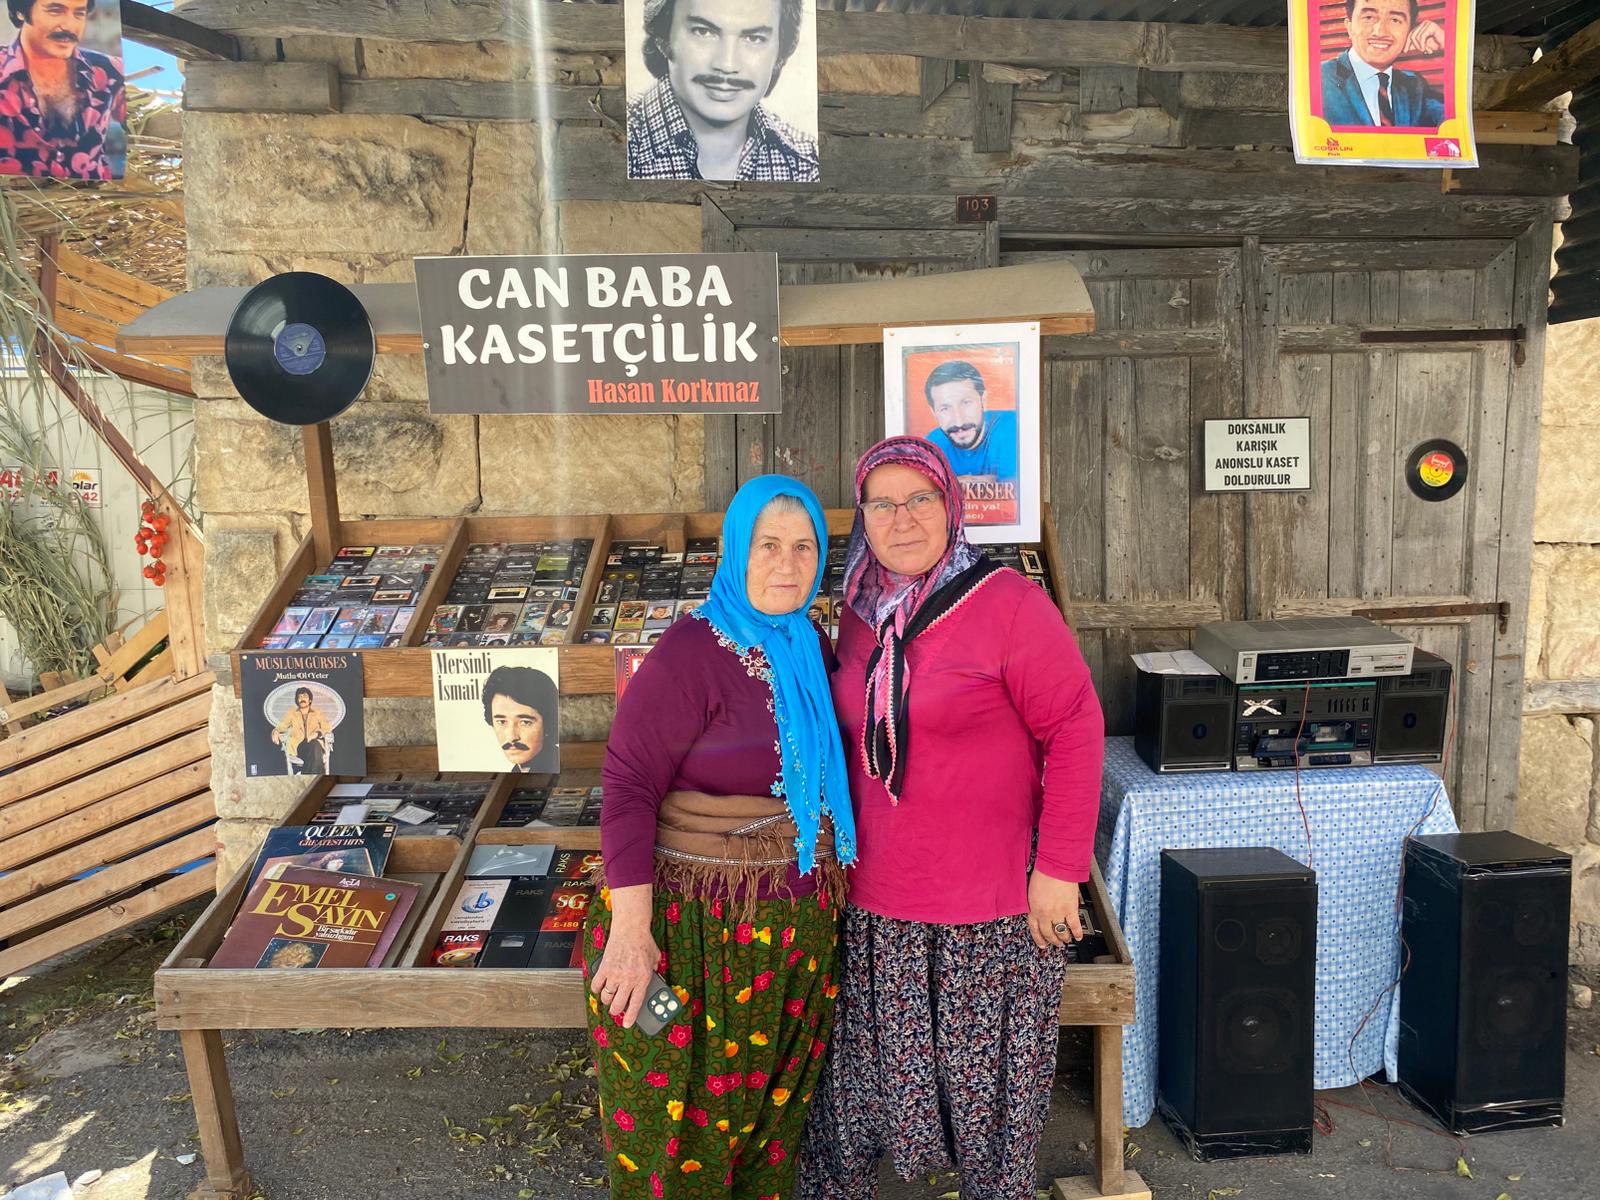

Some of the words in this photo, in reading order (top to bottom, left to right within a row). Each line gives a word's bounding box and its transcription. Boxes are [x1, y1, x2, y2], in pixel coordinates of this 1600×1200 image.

[966, 198, 989, 210] 103
[458, 266, 570, 309] CAN
[585, 265, 733, 308] BABA
[440, 312, 758, 377] KASETÇİLİK
[587, 379, 655, 403] Hasan
[661, 378, 760, 403] Korkmaz
[1228, 423, 1286, 435] DOKSANLIK
[1236, 440, 1278, 454] KARIŞIK
[1215, 457, 1263, 469] ANONSLU
[1266, 457, 1300, 468] KASET
[1224, 474, 1291, 486] DOLDURULUR
[966, 481, 1015, 500] KESER
[255, 656, 304, 670] MÜSLÜM
[436, 652, 492, 674] Mersinli
[438, 675, 480, 701] İsmail
[304, 825, 367, 840] QUEEN
[299, 838, 342, 847] GREATEST
[343, 838, 365, 846] HITS
[555, 853, 571, 873] RAKS
[248, 881, 360, 917] EMEL
[556, 893, 589, 910] SG
[274, 903, 386, 938] SAYIN
[444, 934, 480, 943] RAKS
